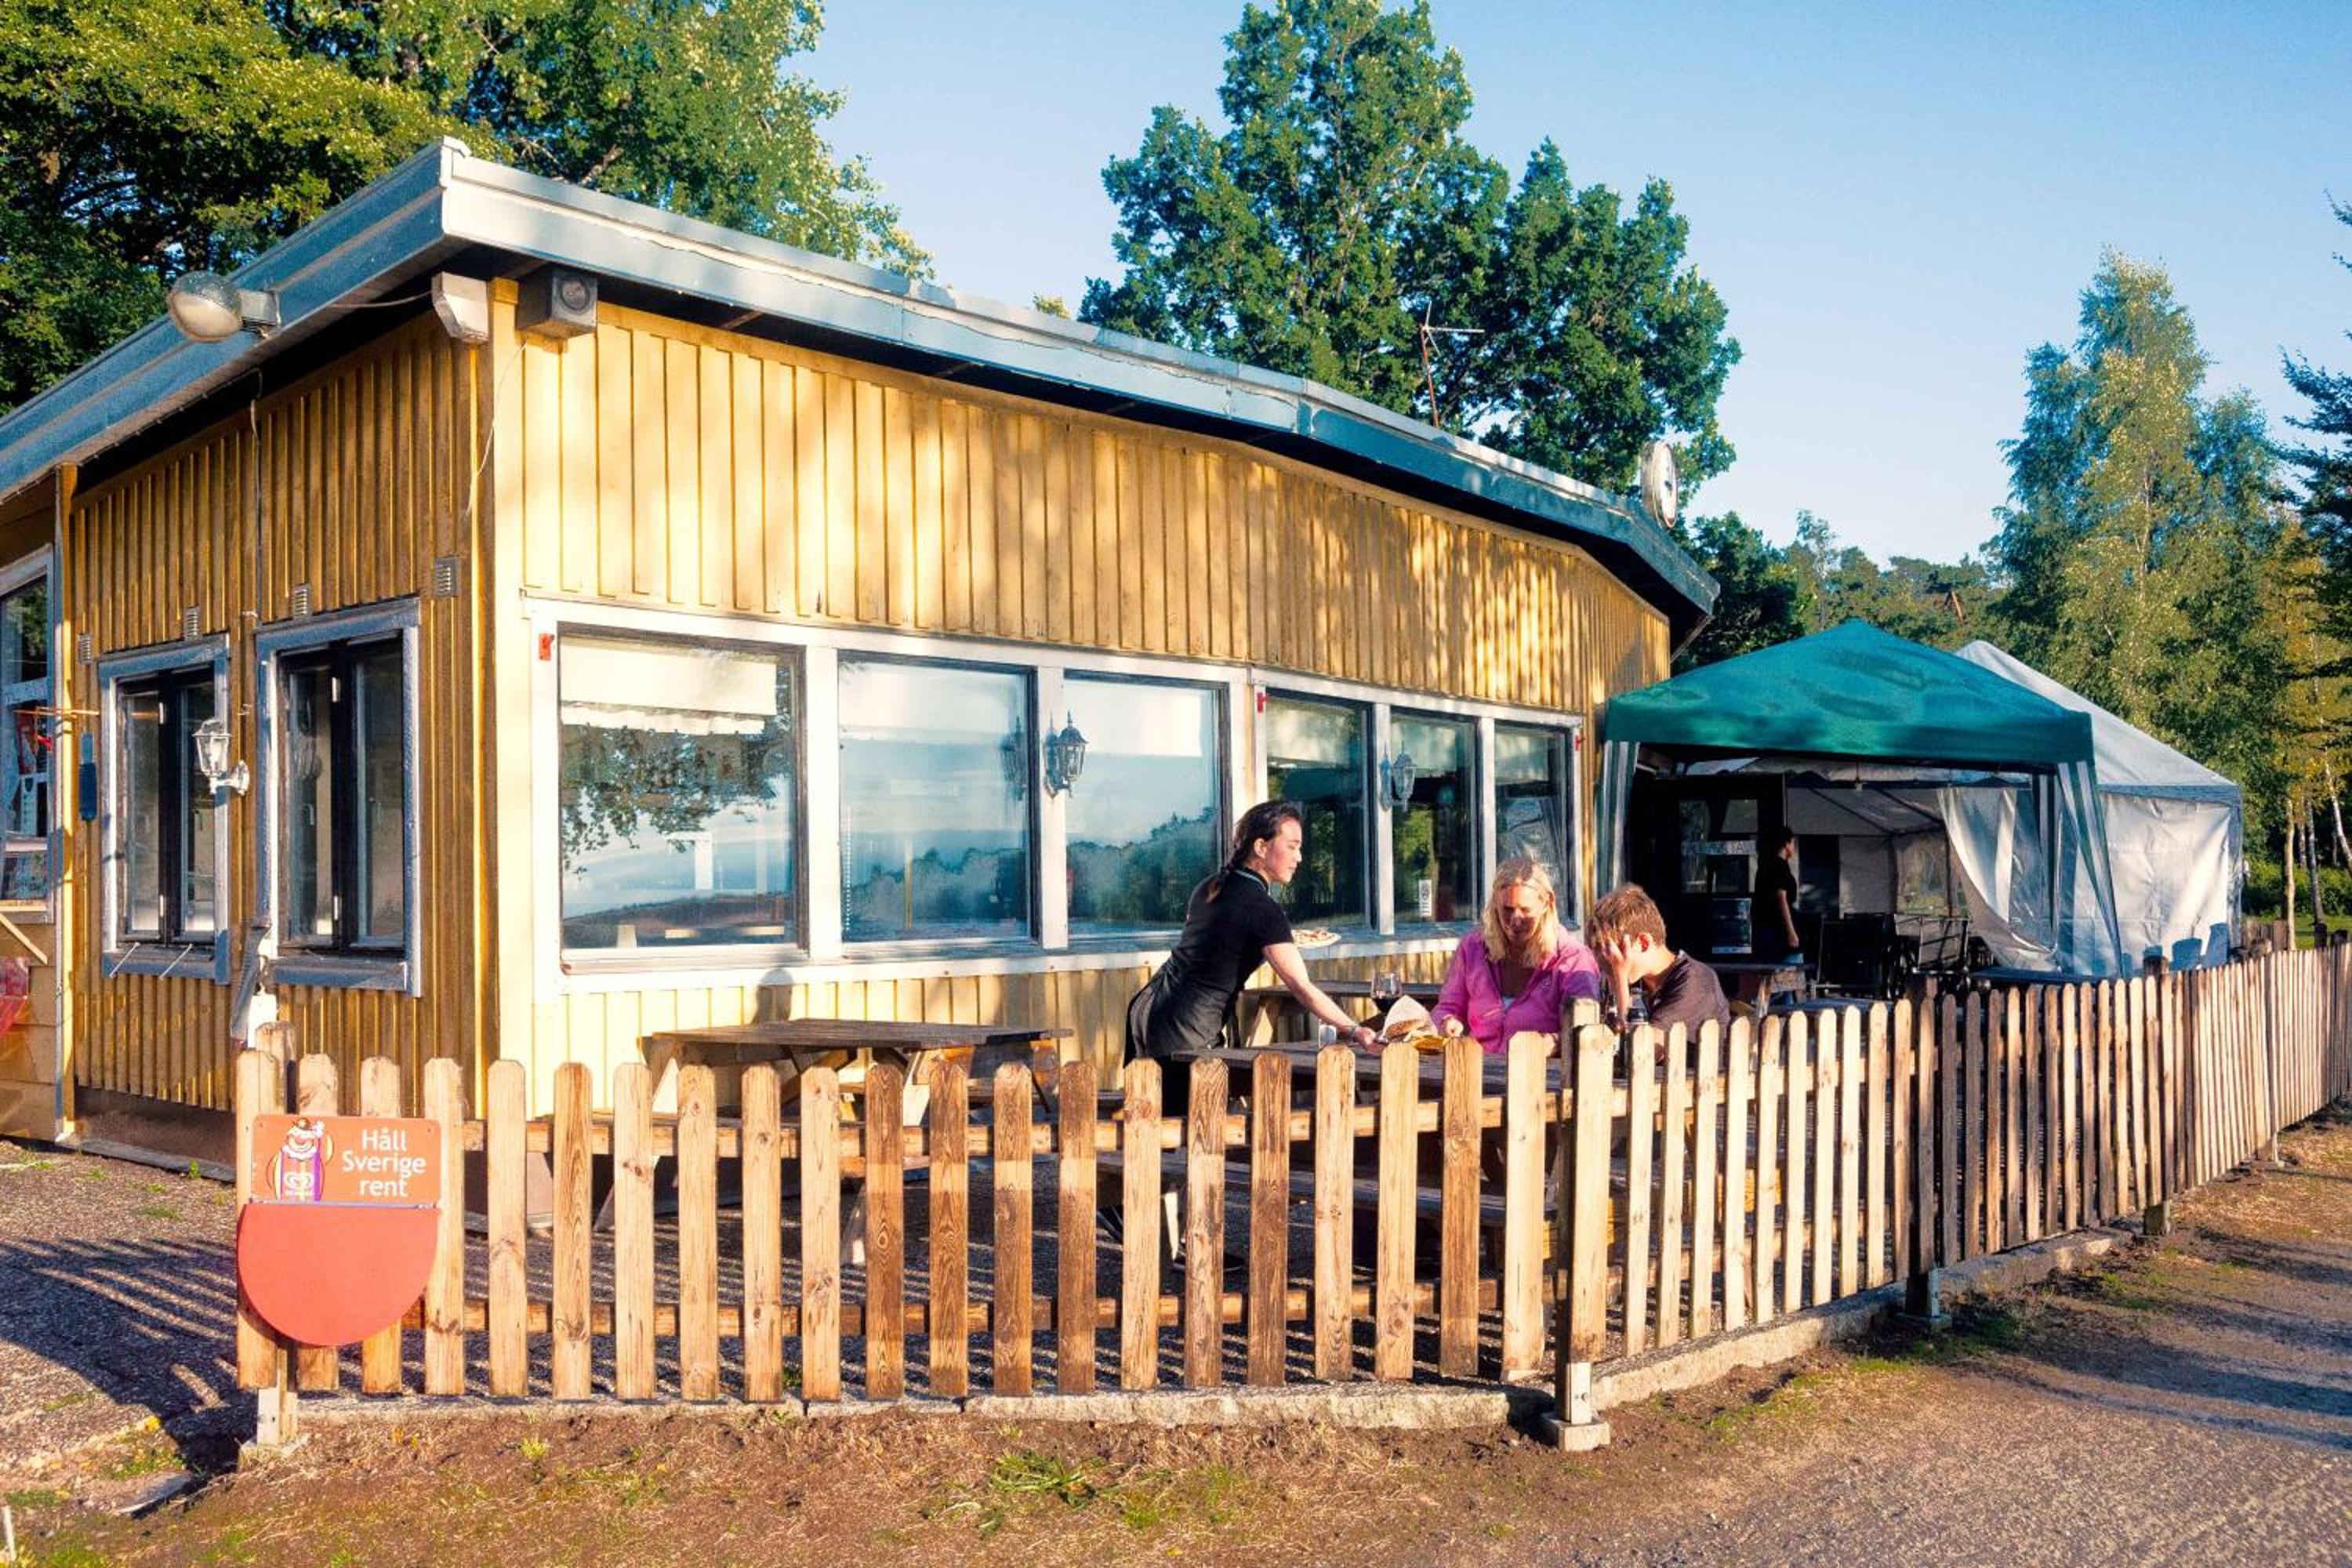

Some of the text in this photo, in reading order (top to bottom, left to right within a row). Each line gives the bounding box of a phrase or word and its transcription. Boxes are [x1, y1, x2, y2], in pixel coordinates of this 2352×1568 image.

[361, 1127, 407, 1152] Håll
[342, 1149, 426, 1178] Sverige
[359, 1178, 408, 1197] rent
